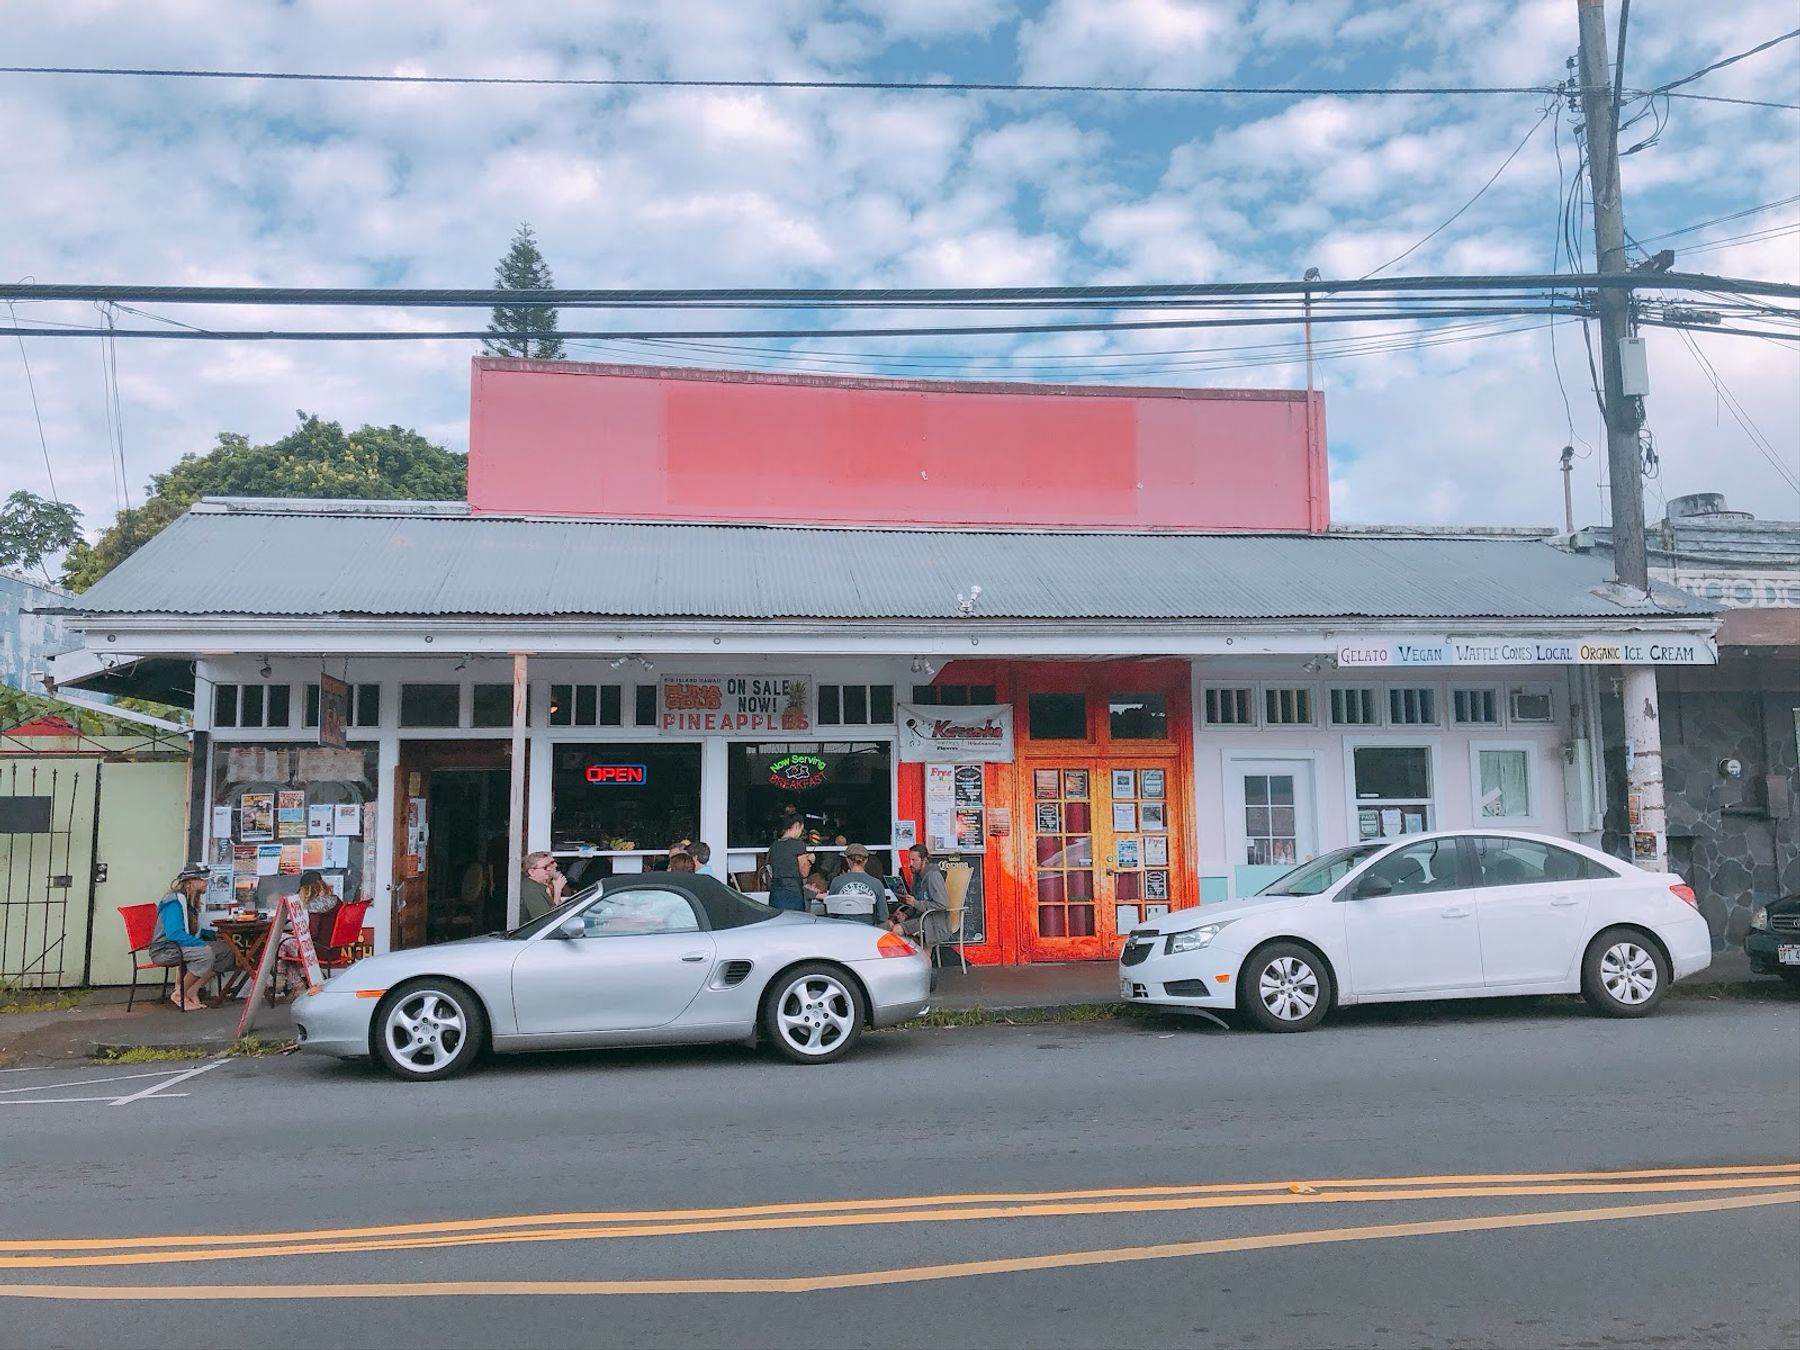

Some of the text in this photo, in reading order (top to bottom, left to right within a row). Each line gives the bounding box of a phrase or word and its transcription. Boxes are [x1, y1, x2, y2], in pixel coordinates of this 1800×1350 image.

[1341, 645, 1695, 664] GELATO VEGAN WAFFLE CONES LOCAL ORGANIC ICE CREAM
[727, 678, 790, 696] ON SALE
[738, 696, 777, 713] NOW!
[663, 712, 809, 730] PINEAPPLES
[931, 719, 1004, 738] Karaoke
[769, 754, 826, 773] Now Serving
[930, 767, 952, 777] Free
[585, 766, 643, 782] OPEN
